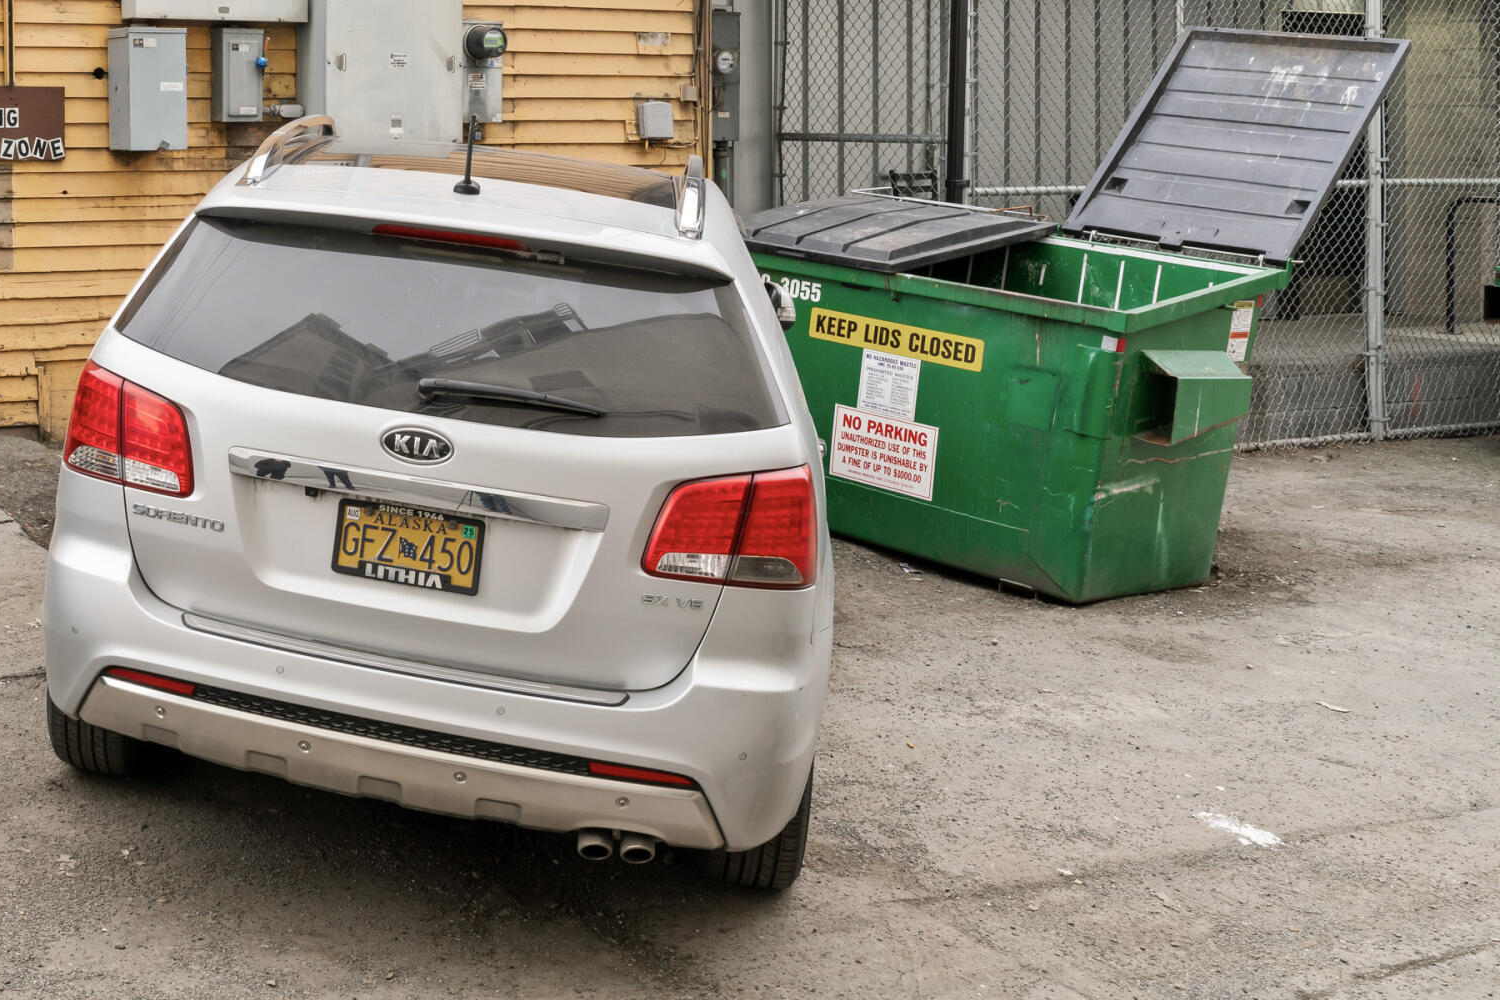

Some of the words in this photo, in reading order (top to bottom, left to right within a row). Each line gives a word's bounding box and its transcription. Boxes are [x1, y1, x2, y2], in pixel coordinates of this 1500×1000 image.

[1, 138, 64, 160] ZONE
[780, 277, 822, 302] 3055
[815, 314, 858, 339] KEEP
[863, 323, 902, 349] LIDS
[908, 332, 977, 364] CLOSED
[842, 413, 862, 431] NO
[867, 419, 928, 448] PARKING
[394, 433, 440, 458] KIA
[837, 442, 870, 458] DUMPSTER
[871, 450, 878, 460] IS
[879, 452, 917, 470] PUNISHABLE
[919, 462, 928, 473] BY
[841, 431, 886, 450] UNAUTHORIZED
[888, 443, 900, 454] USE
[902, 446, 911, 456] OF
[913, 448, 927, 460] THIS
[841, 455, 846, 464] A
[848, 457, 861, 468] FINE
[863, 460, 871, 470] OF
[873, 464, 882, 473] UP
[883, 466, 891, 476] TO
[893, 468, 922, 484] $1000.00
[132, 503, 225, 533] SORENTO
[347, 508, 359, 519] AUG
[373, 513, 448, 535] ALASKA
[378, 504, 414, 517] SINCE
[417, 510, 445, 521] 1946
[463, 526, 475, 536] 25
[342, 521, 398, 563] GFZ
[418, 534, 474, 576] 450
[364, 562, 443, 590] LITHIA
